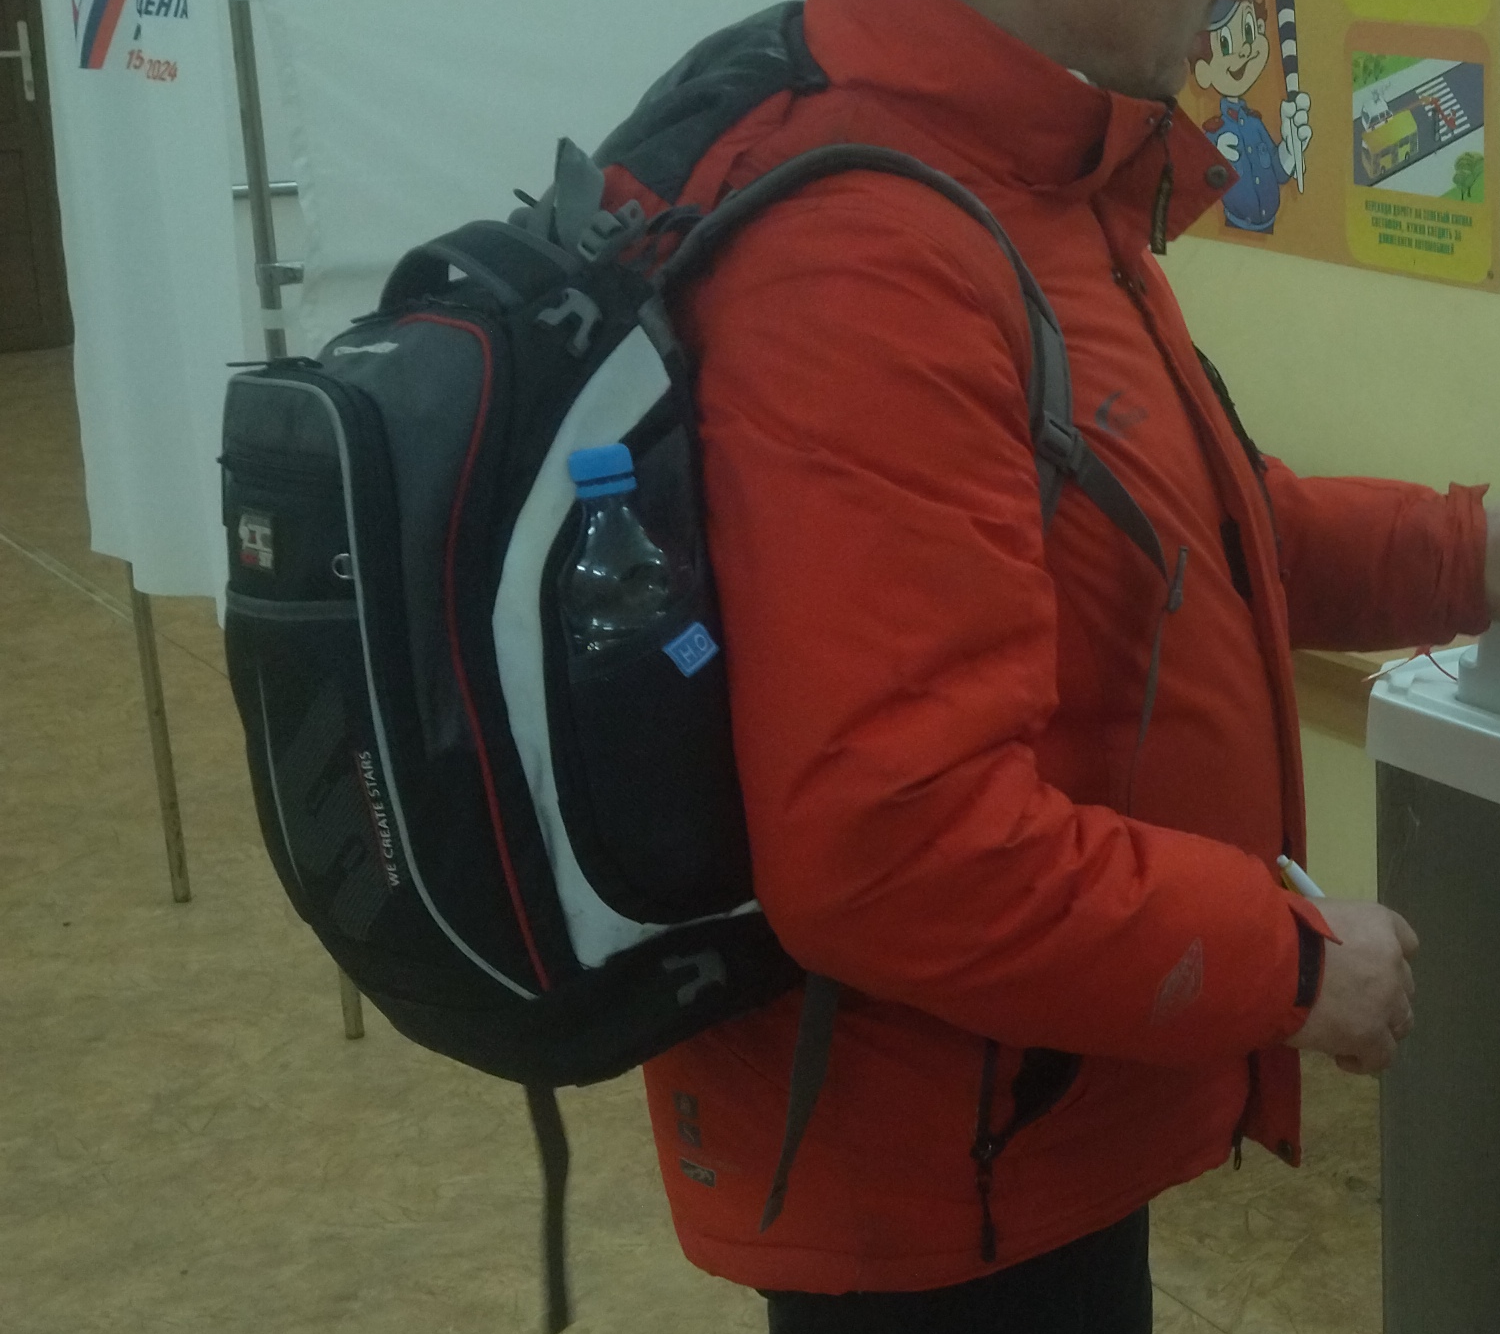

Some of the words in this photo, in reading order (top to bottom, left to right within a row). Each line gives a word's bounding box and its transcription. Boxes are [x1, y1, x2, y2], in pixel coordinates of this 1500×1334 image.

[359, 750, 381, 798] STARS
[371, 801, 395, 859] CREATE
[385, 862, 401, 887] WE
